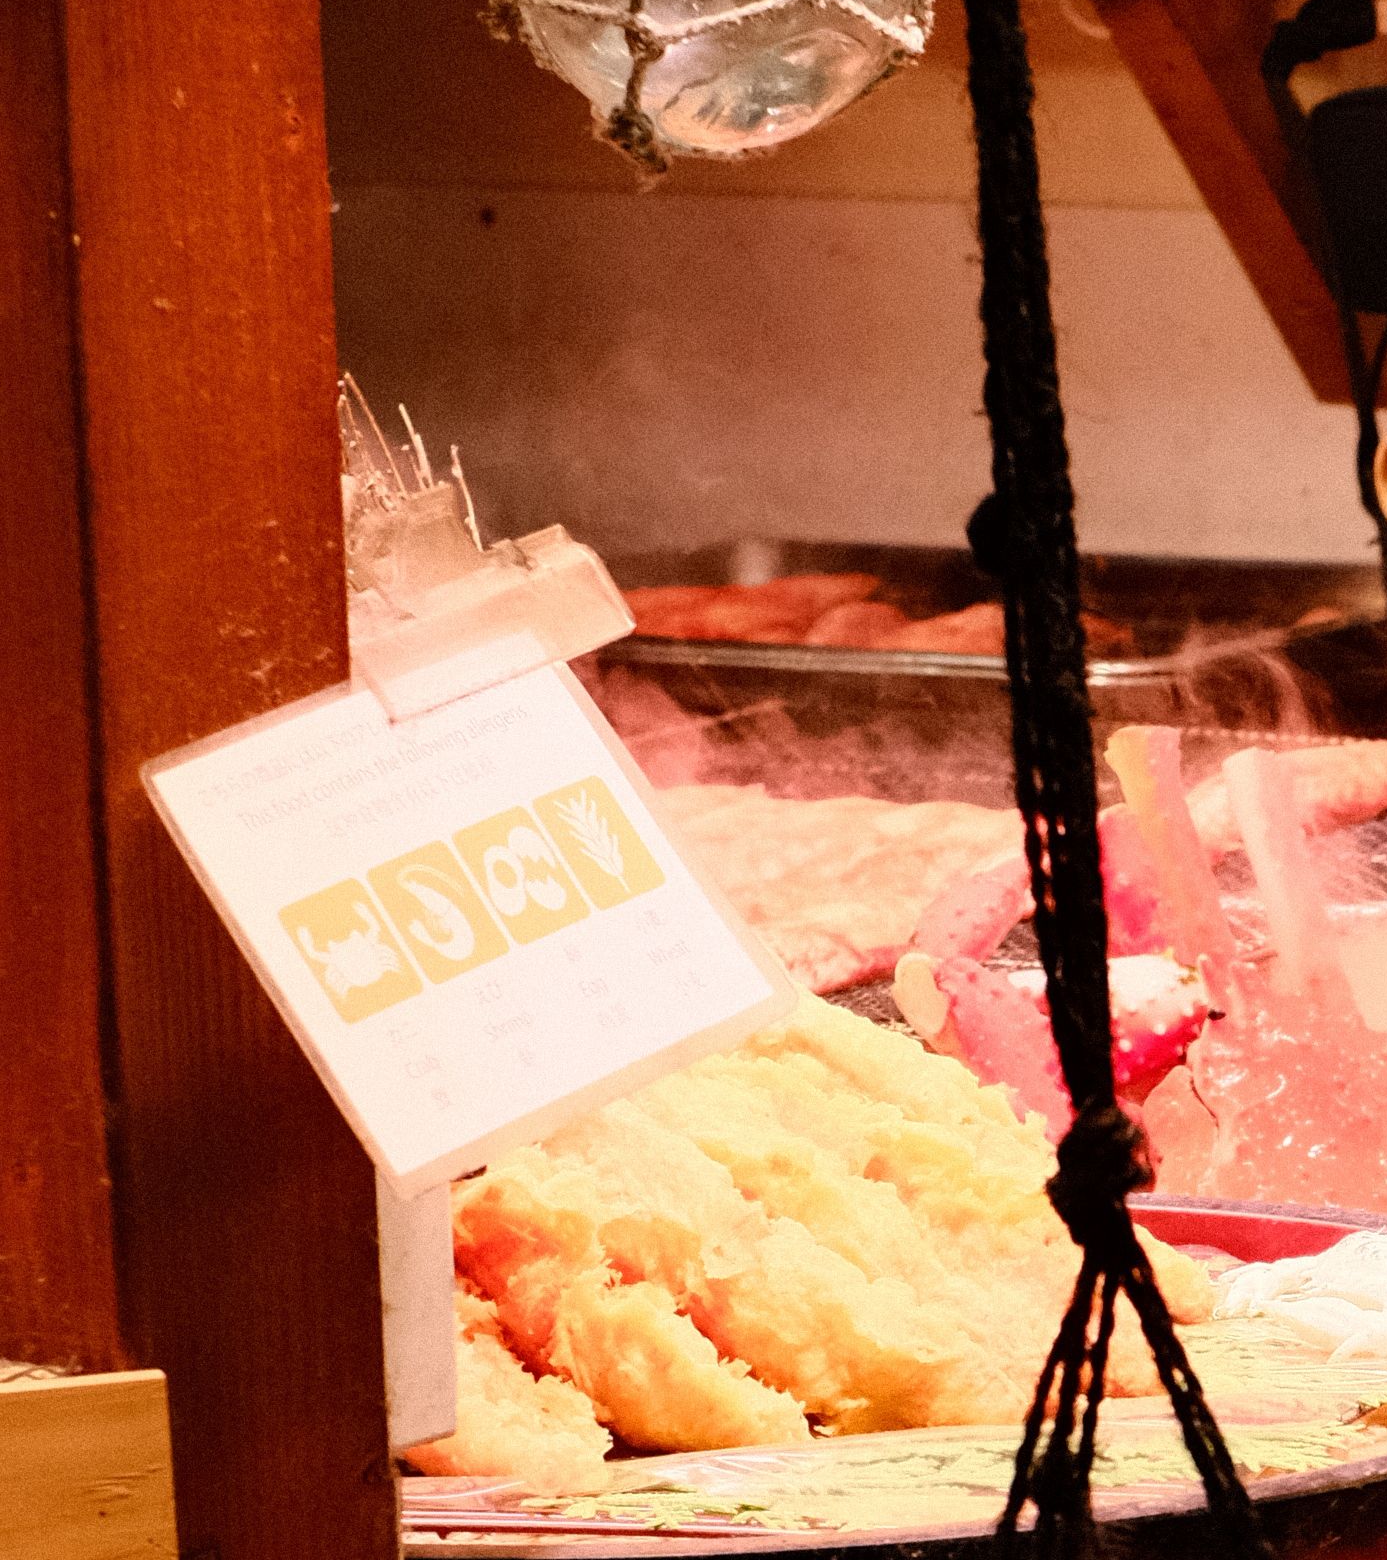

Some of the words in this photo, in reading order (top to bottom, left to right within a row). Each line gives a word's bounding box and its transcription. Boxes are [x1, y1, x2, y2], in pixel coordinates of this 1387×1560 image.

[235, 810, 274, 833] This
[271, 795, 310, 822] food
[312, 763, 376, 803] contains
[374, 752, 401, 778] the
[399, 727, 467, 765] following
[646, 937, 692, 968] Wheat
[577, 976, 610, 1005] Egg
[481, 1009, 537, 1046] Shrimp
[403, 1051, 443, 1082] Crab
